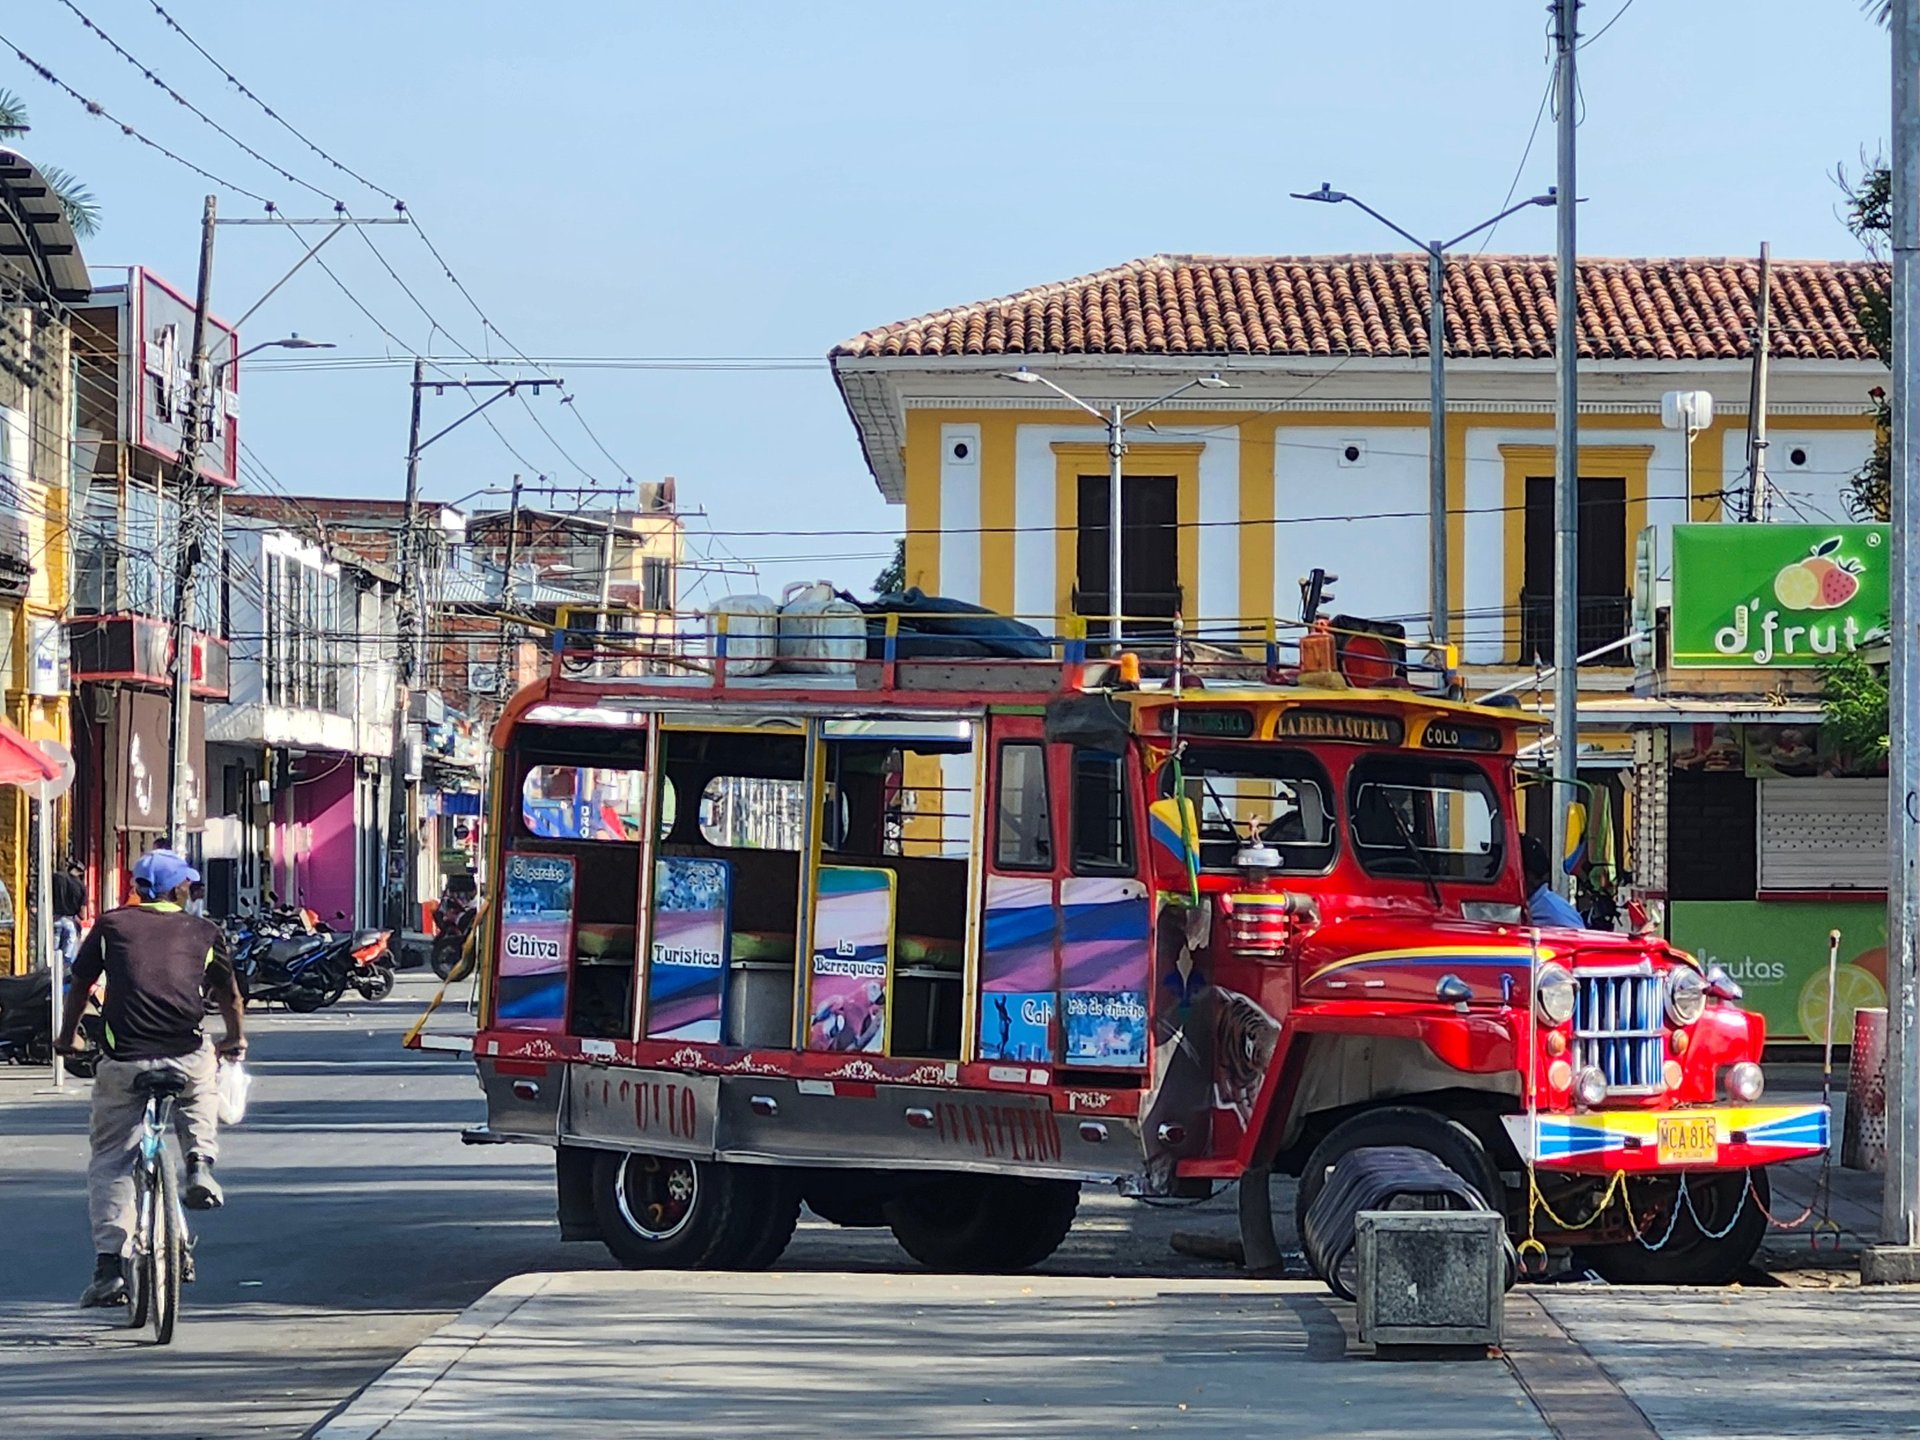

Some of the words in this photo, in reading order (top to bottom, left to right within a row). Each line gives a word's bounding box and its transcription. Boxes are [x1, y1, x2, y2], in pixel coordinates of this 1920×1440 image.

[1277, 716, 1297, 736] LA
[506, 933, 560, 958] Chiva
[837, 938, 854, 954] La
[814, 956, 886, 977] Berraquera
[1690, 1126, 1715, 1149] 815
